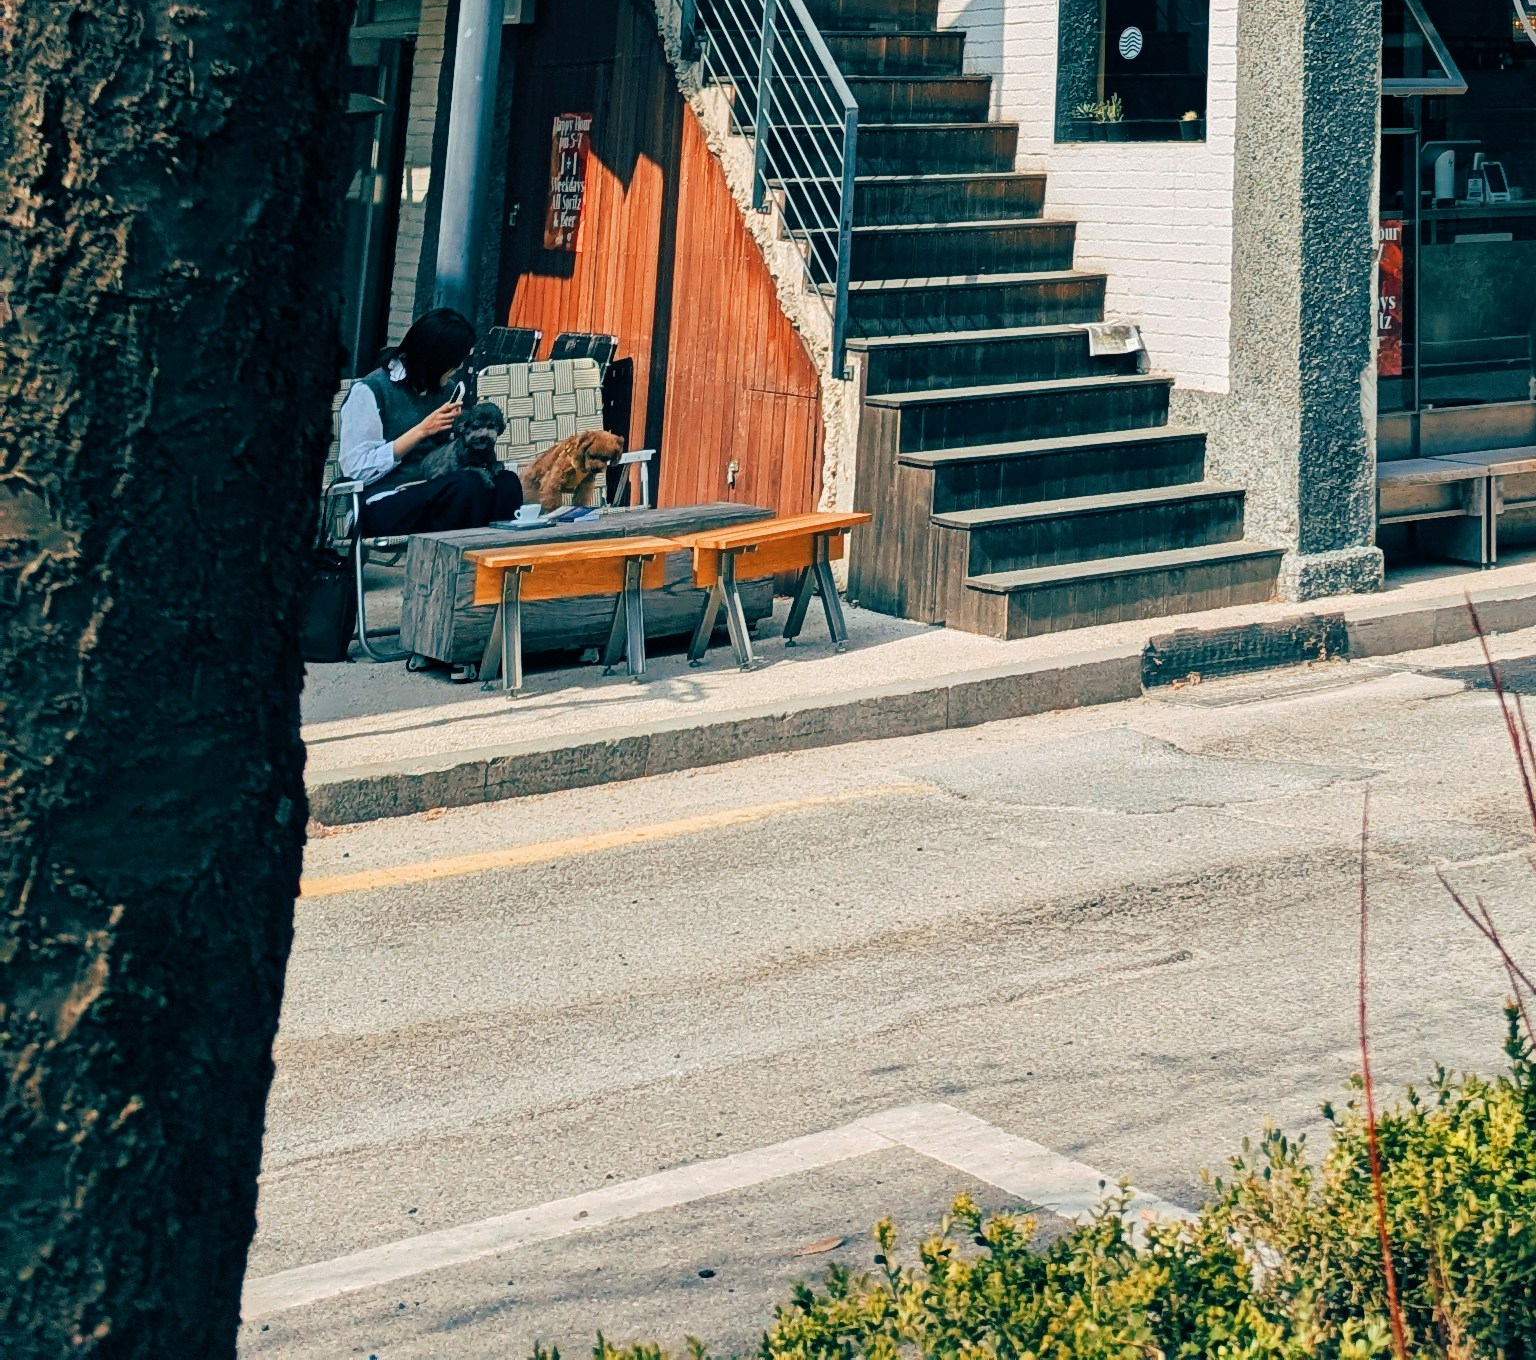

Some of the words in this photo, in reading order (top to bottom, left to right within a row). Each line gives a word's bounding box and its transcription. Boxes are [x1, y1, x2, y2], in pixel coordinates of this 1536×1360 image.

[553, 116, 573, 137] Happy
[574, 116, 592, 131] Hour
[559, 137, 569, 153] pm
[570, 132, 583, 149] 5-7
[551, 176, 585, 193] Weekdays
[551, 194, 561, 210] All
[562, 194, 582, 214] Spritz
[560, 211, 577, 228] Beer
